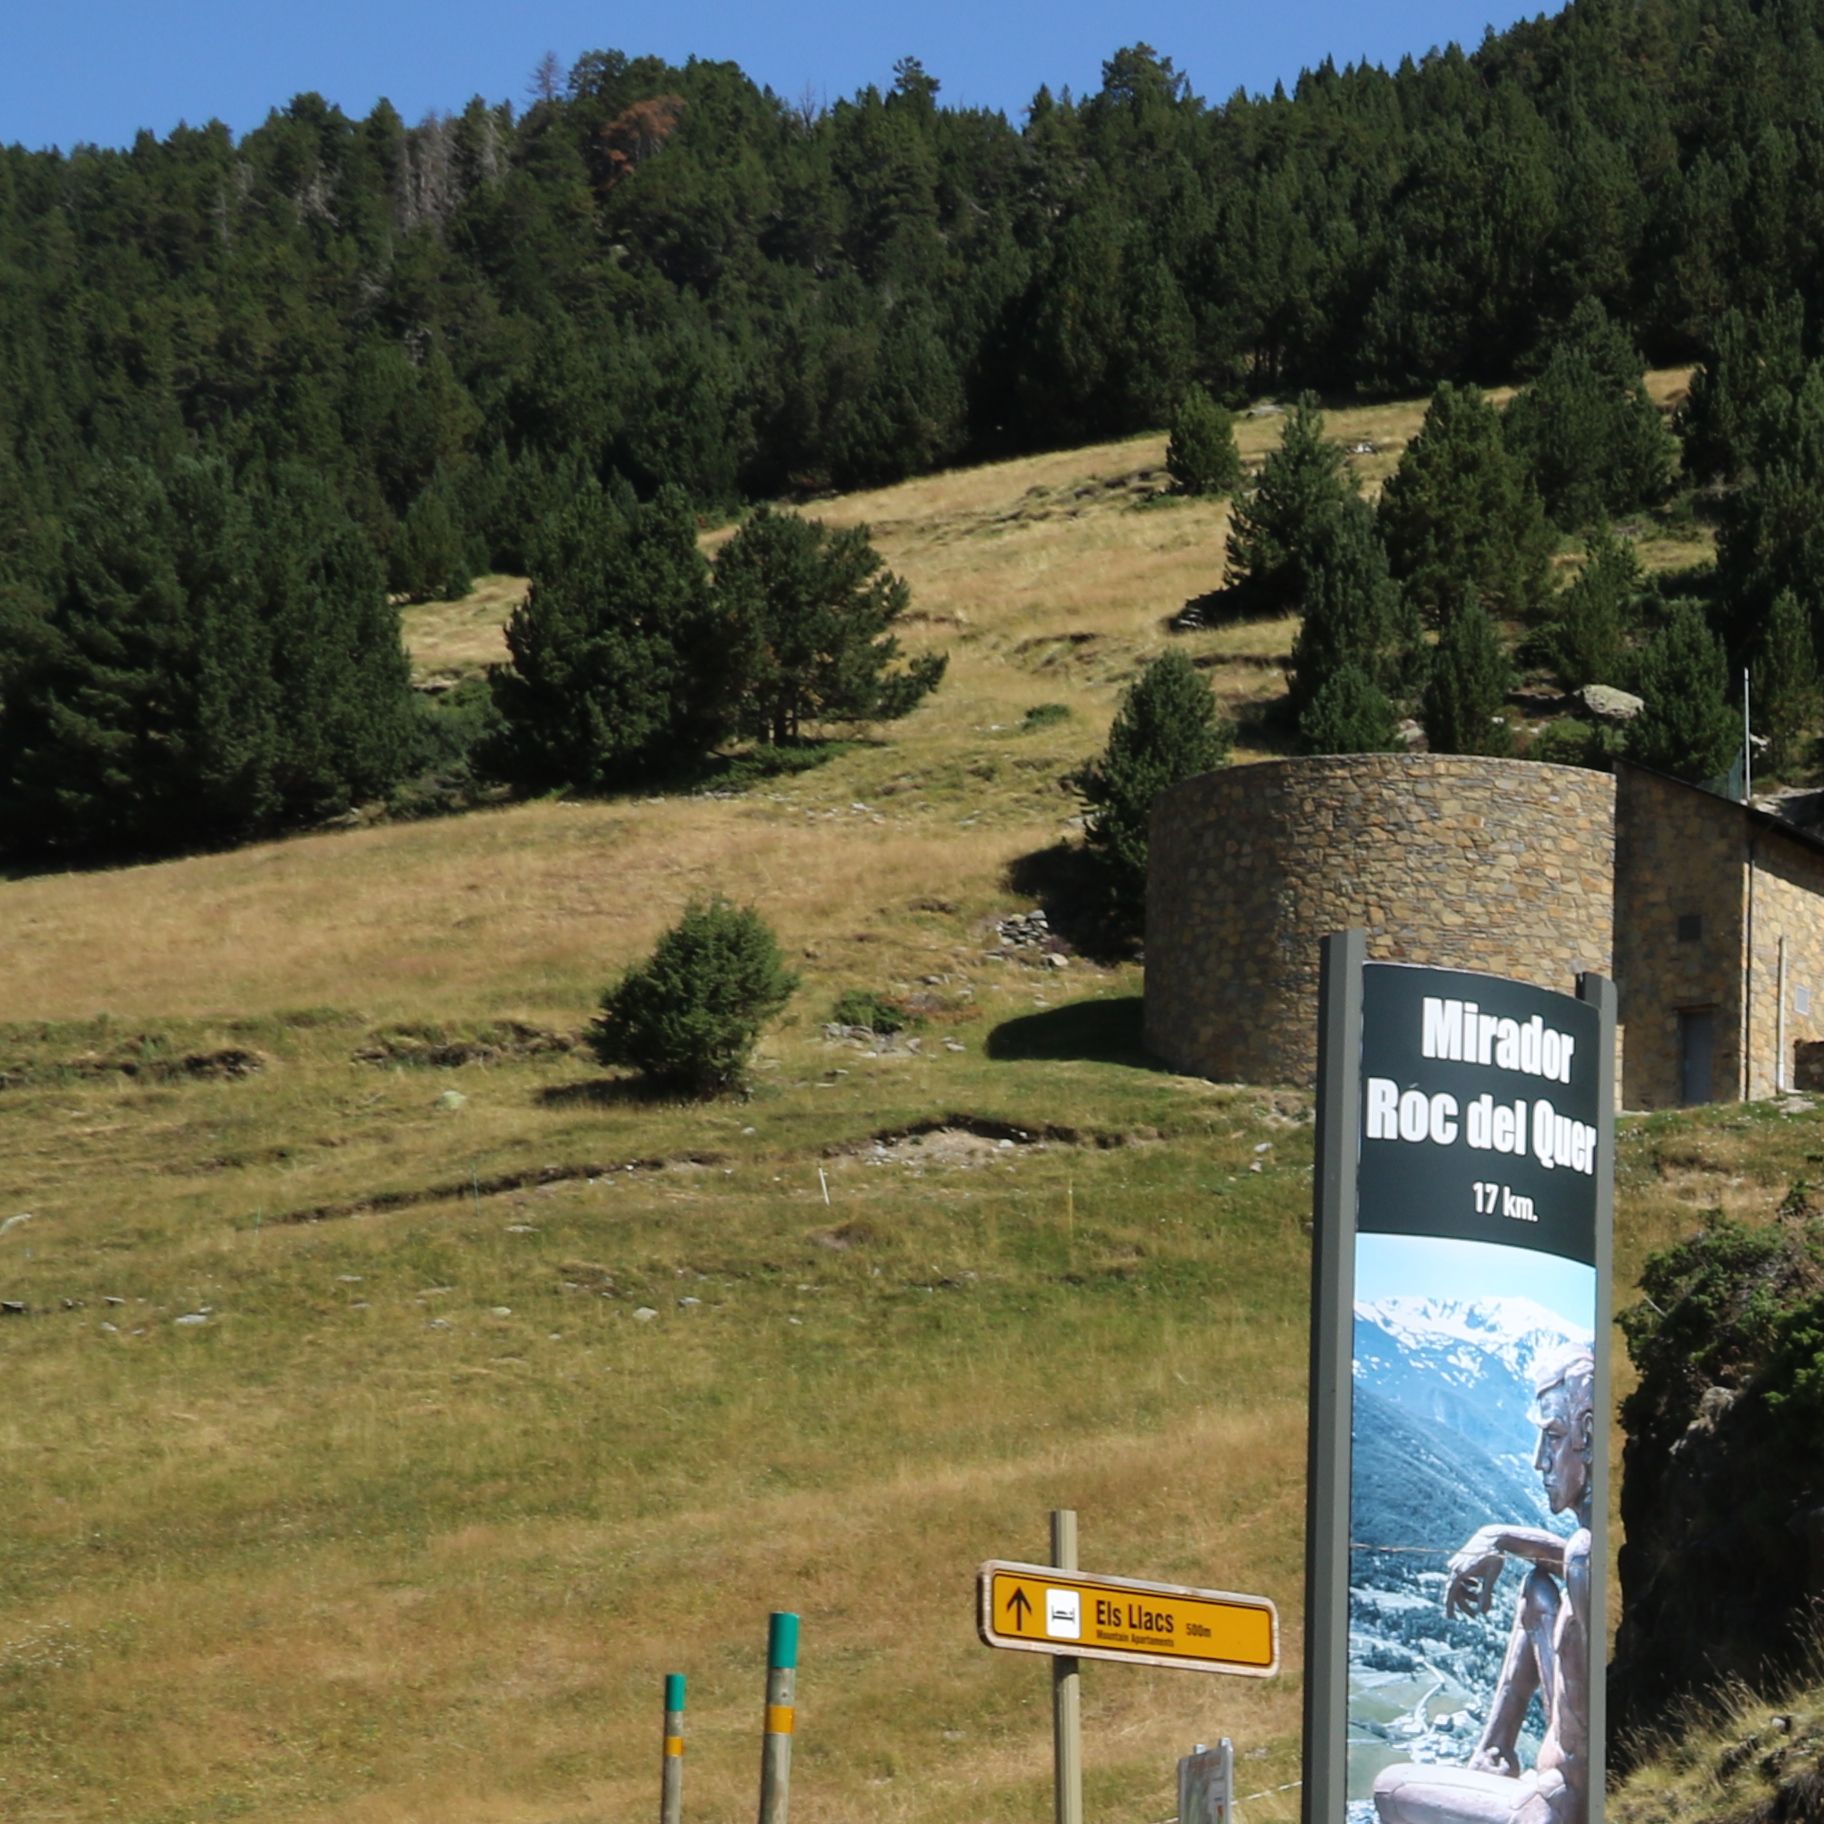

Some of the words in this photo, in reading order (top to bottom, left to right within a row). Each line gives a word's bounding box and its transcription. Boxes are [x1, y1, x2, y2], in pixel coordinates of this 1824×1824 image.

[1421, 997, 1575, 1084] Mirador
[1366, 1077, 1459, 1145] Roc
[1466, 1093, 1527, 1156] del
[1532, 1099, 1598, 1175] Quer
[1472, 1181, 1499, 1215] 17
[1502, 1186, 1538, 1222] km.
[1096, 1600, 1121, 1627] Els
[1128, 1604, 1174, 1633] Llacs
[1186, 1623, 1211, 1638] 500m
[1096, 1630, 1129, 1642] Mountain
